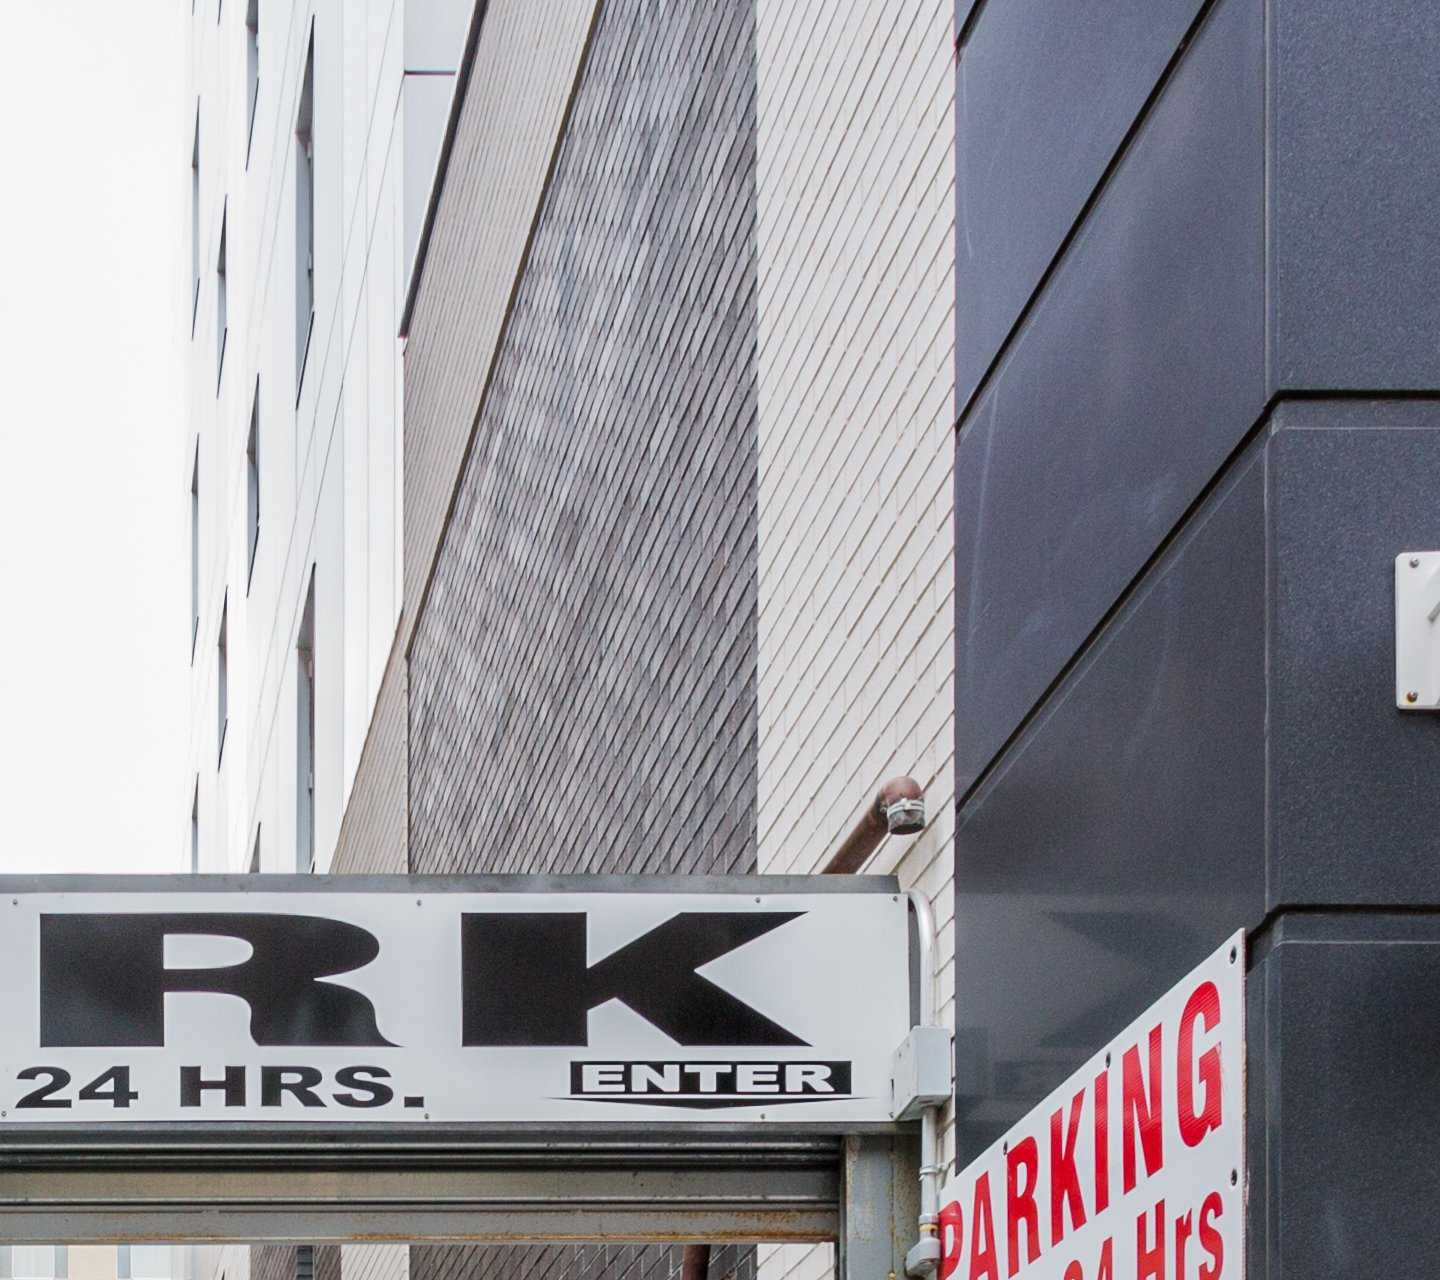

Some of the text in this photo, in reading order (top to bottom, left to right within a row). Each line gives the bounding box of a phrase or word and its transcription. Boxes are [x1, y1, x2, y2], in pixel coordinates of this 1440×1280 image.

[14, 1065, 140, 1109] 24
[179, 1065, 426, 1109] HRS.
[580, 1062, 838, 1095] ENTER
